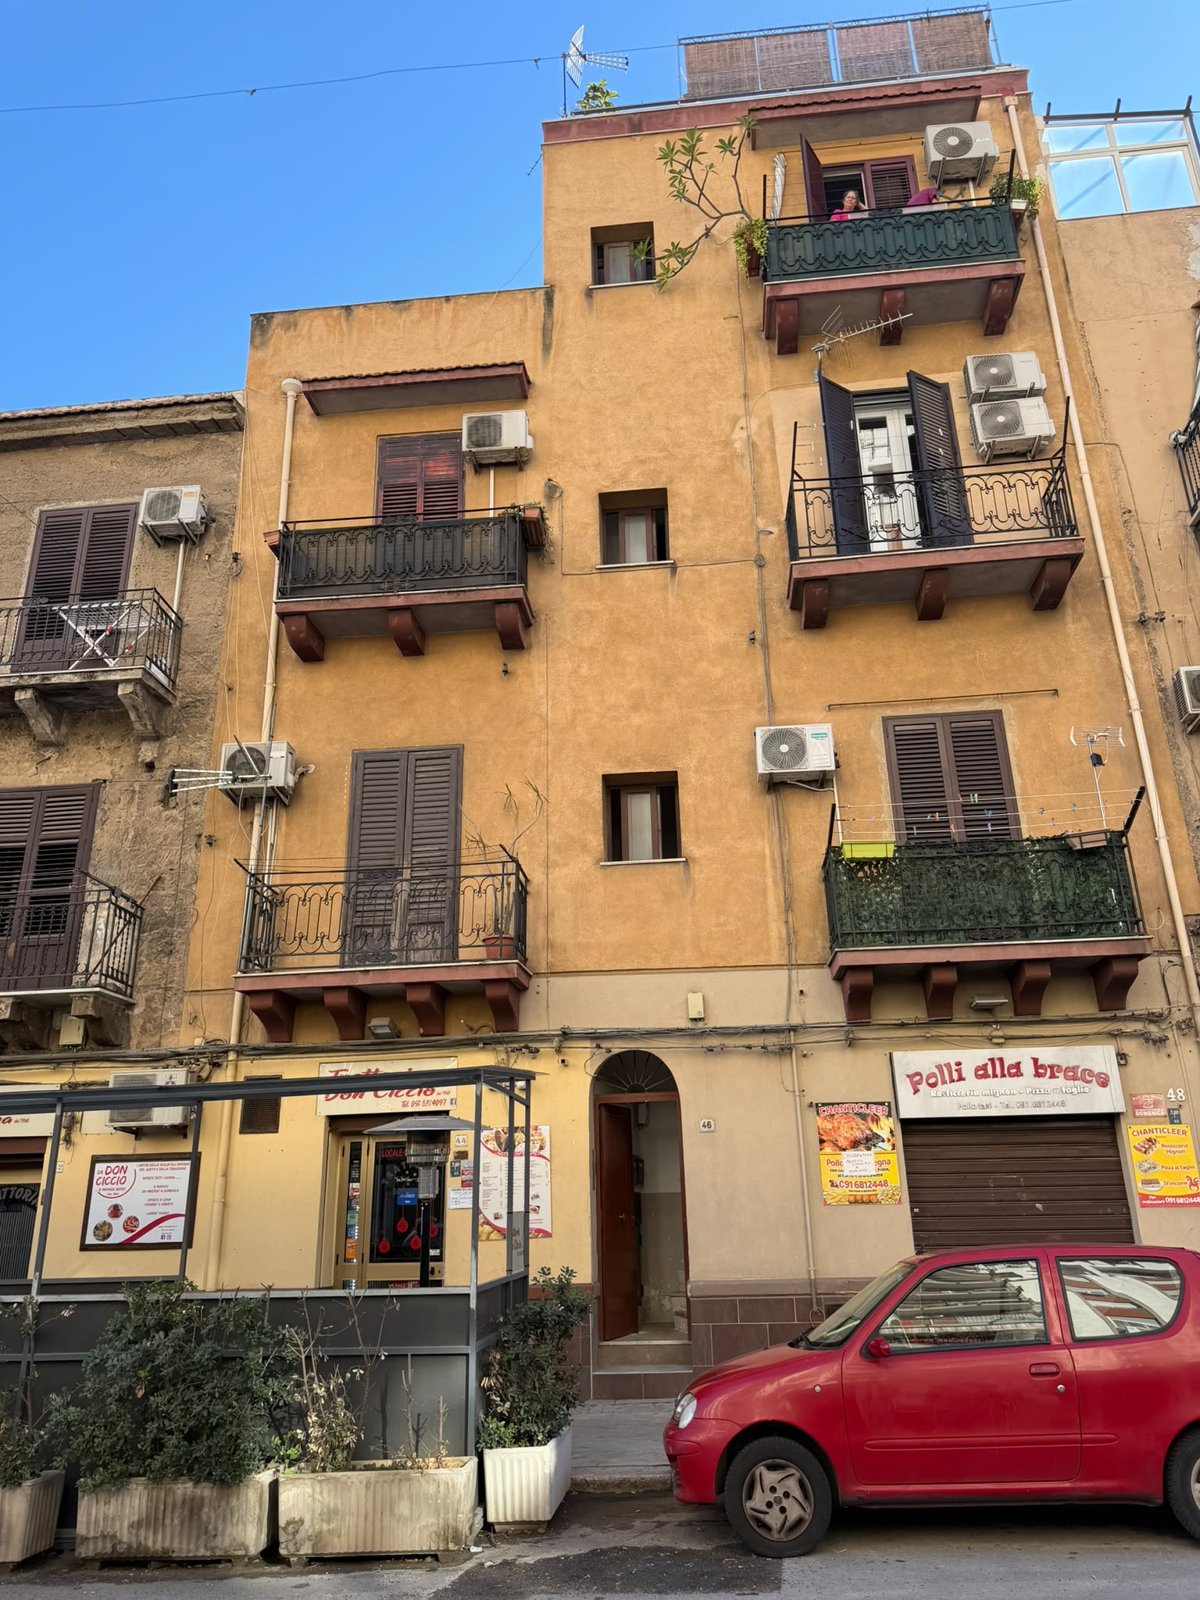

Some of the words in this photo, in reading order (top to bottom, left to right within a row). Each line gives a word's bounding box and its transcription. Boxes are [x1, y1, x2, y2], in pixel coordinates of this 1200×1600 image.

[906, 1061, 966, 1095] Polli
[974, 1057, 1024, 1080] alla
[1031, 1057, 1110, 1088] brace
[982, 1088, 1016, 1098] mignon
[1026, 1087, 1051, 1095] Pizza
[1061, 1086, 1090, 1096] taglio
[1167, 1088, 1185, 1101] 48
[819, 1103, 888, 1116] CHANTICLEER
[702, 1121, 712, 1129] 46
[1131, 1127, 1188, 1137] CHANTICLEER
[456, 1137, 466, 1145] 44
[381, 1149, 403, 1158] LOCALE
[104, 1165, 129, 1175] DON
[95, 1175, 127, 1186] CICCIO
[854, 1179, 889, 1188] 6812448
